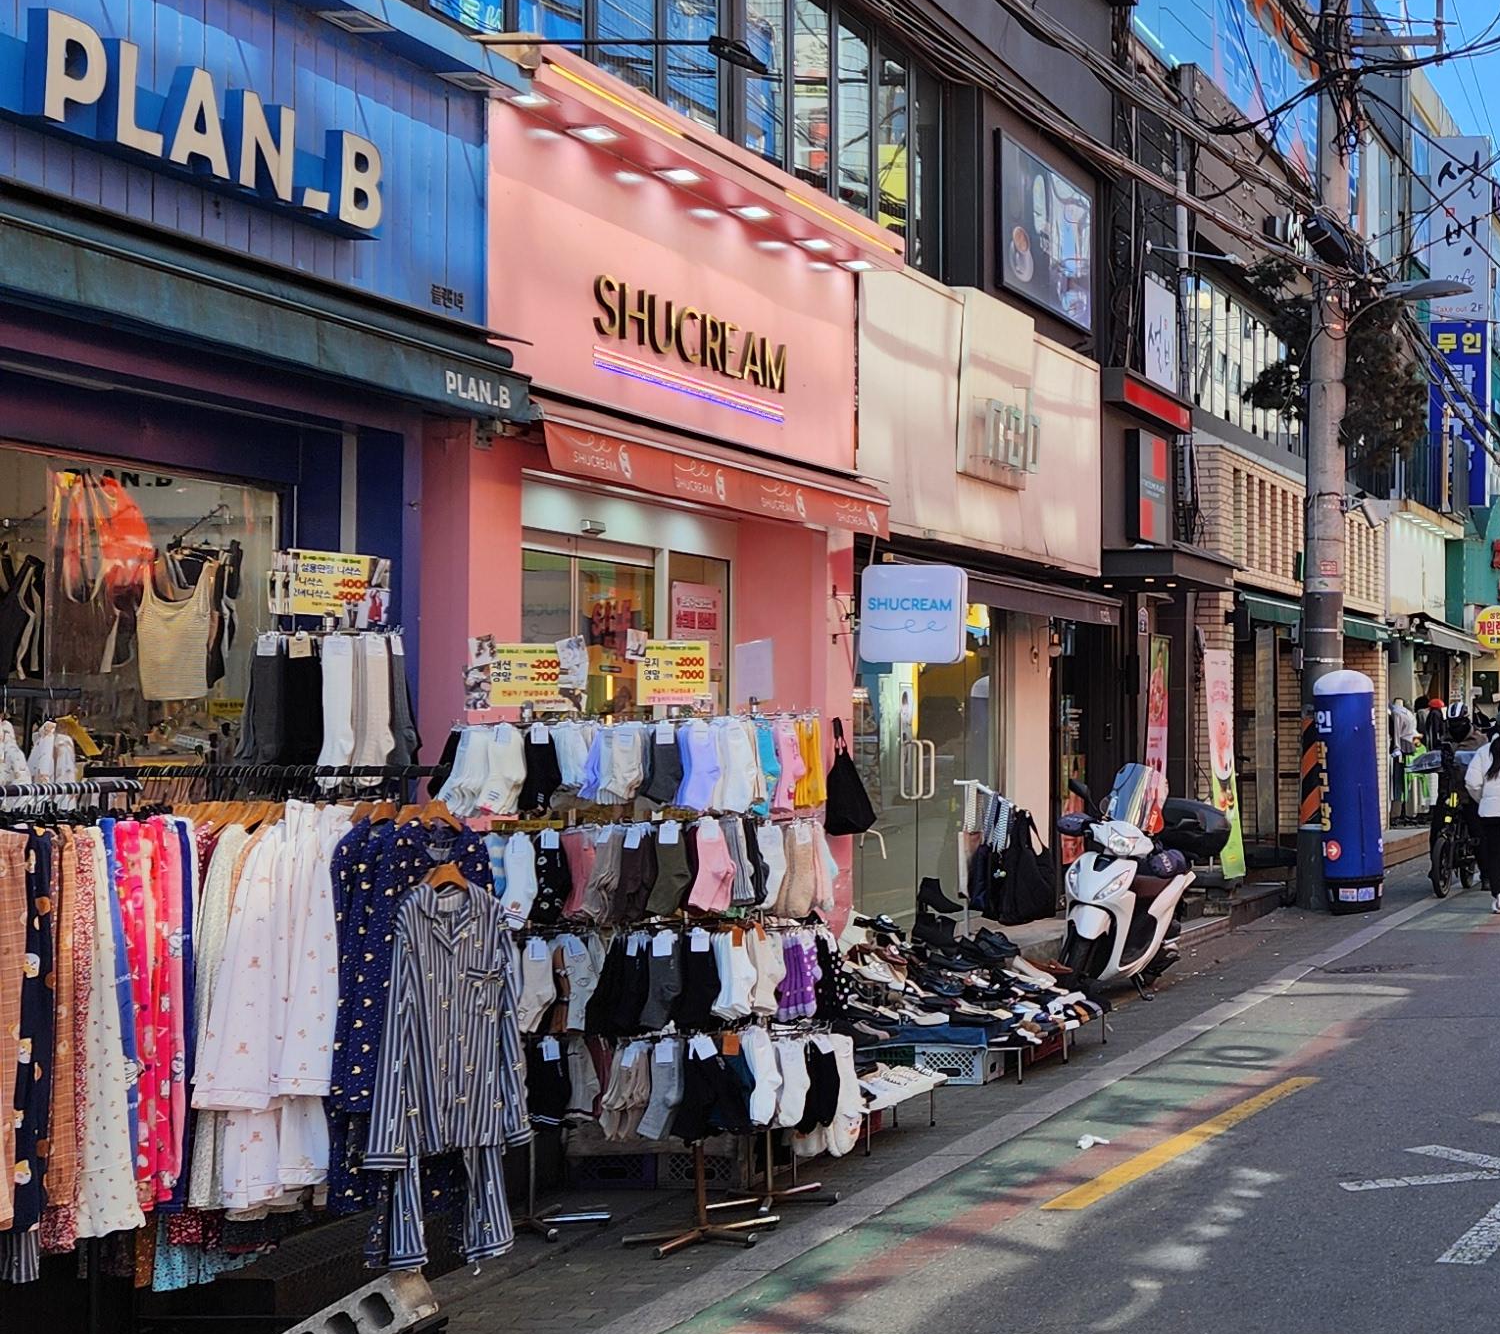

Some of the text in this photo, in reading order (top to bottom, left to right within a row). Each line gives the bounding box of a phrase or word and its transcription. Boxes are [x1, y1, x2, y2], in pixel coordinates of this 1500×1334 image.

[1470, 302, 1484, 314] 2F
[593, 273, 787, 394] SHUCREAM
[1437, 332, 1482, 354] 무인
[573, 450, 618, 474] SHUCREAM
[867, 597, 953, 612] SHUCREAM
